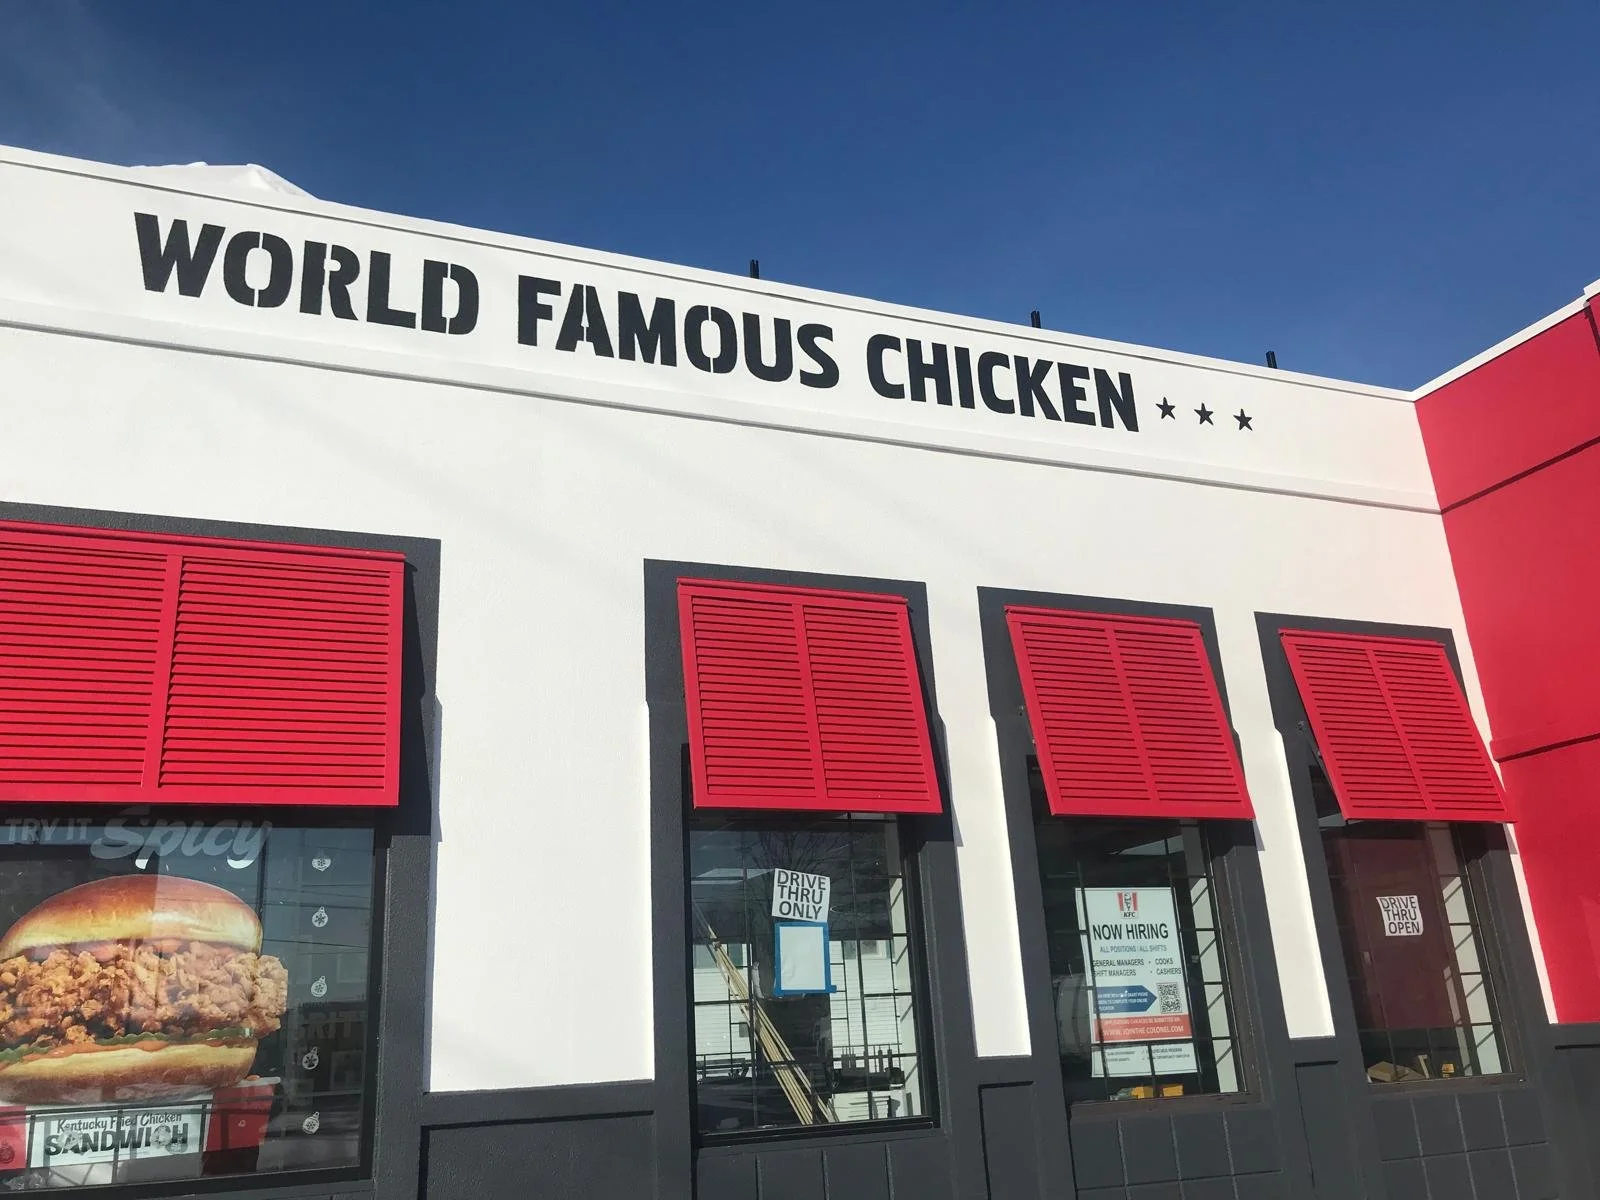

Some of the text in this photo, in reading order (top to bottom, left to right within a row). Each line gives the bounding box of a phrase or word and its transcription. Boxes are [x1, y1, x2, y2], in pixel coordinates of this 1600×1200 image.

[135, 212, 1139, 433] WORLD FAMOUS CHICKEN
[4, 806, 272, 870] TRY IT Spicy
[777, 870, 827, 890] DRIVE
[777, 884, 823, 904] THRU
[1379, 896, 1416, 909] DRIVE
[779, 901, 822, 920] ONLY
[1384, 909, 1417, 921] THRU
[1092, 923, 1169, 940] NOW HIRING
[1388, 921, 1420, 934] OPEN
[1099, 945, 1110, 953] ALL
[1110, 945, 1136, 953] POSITIONS
[1148, 944, 1167, 952] SHIFTS
[1093, 958, 1144, 967] GENERAL MANAGERS
[1155, 957, 1173, 965] COOKS
[57, 1117, 106, 1133] Kentucky
[140, 1112, 182, 1126] Chicken
